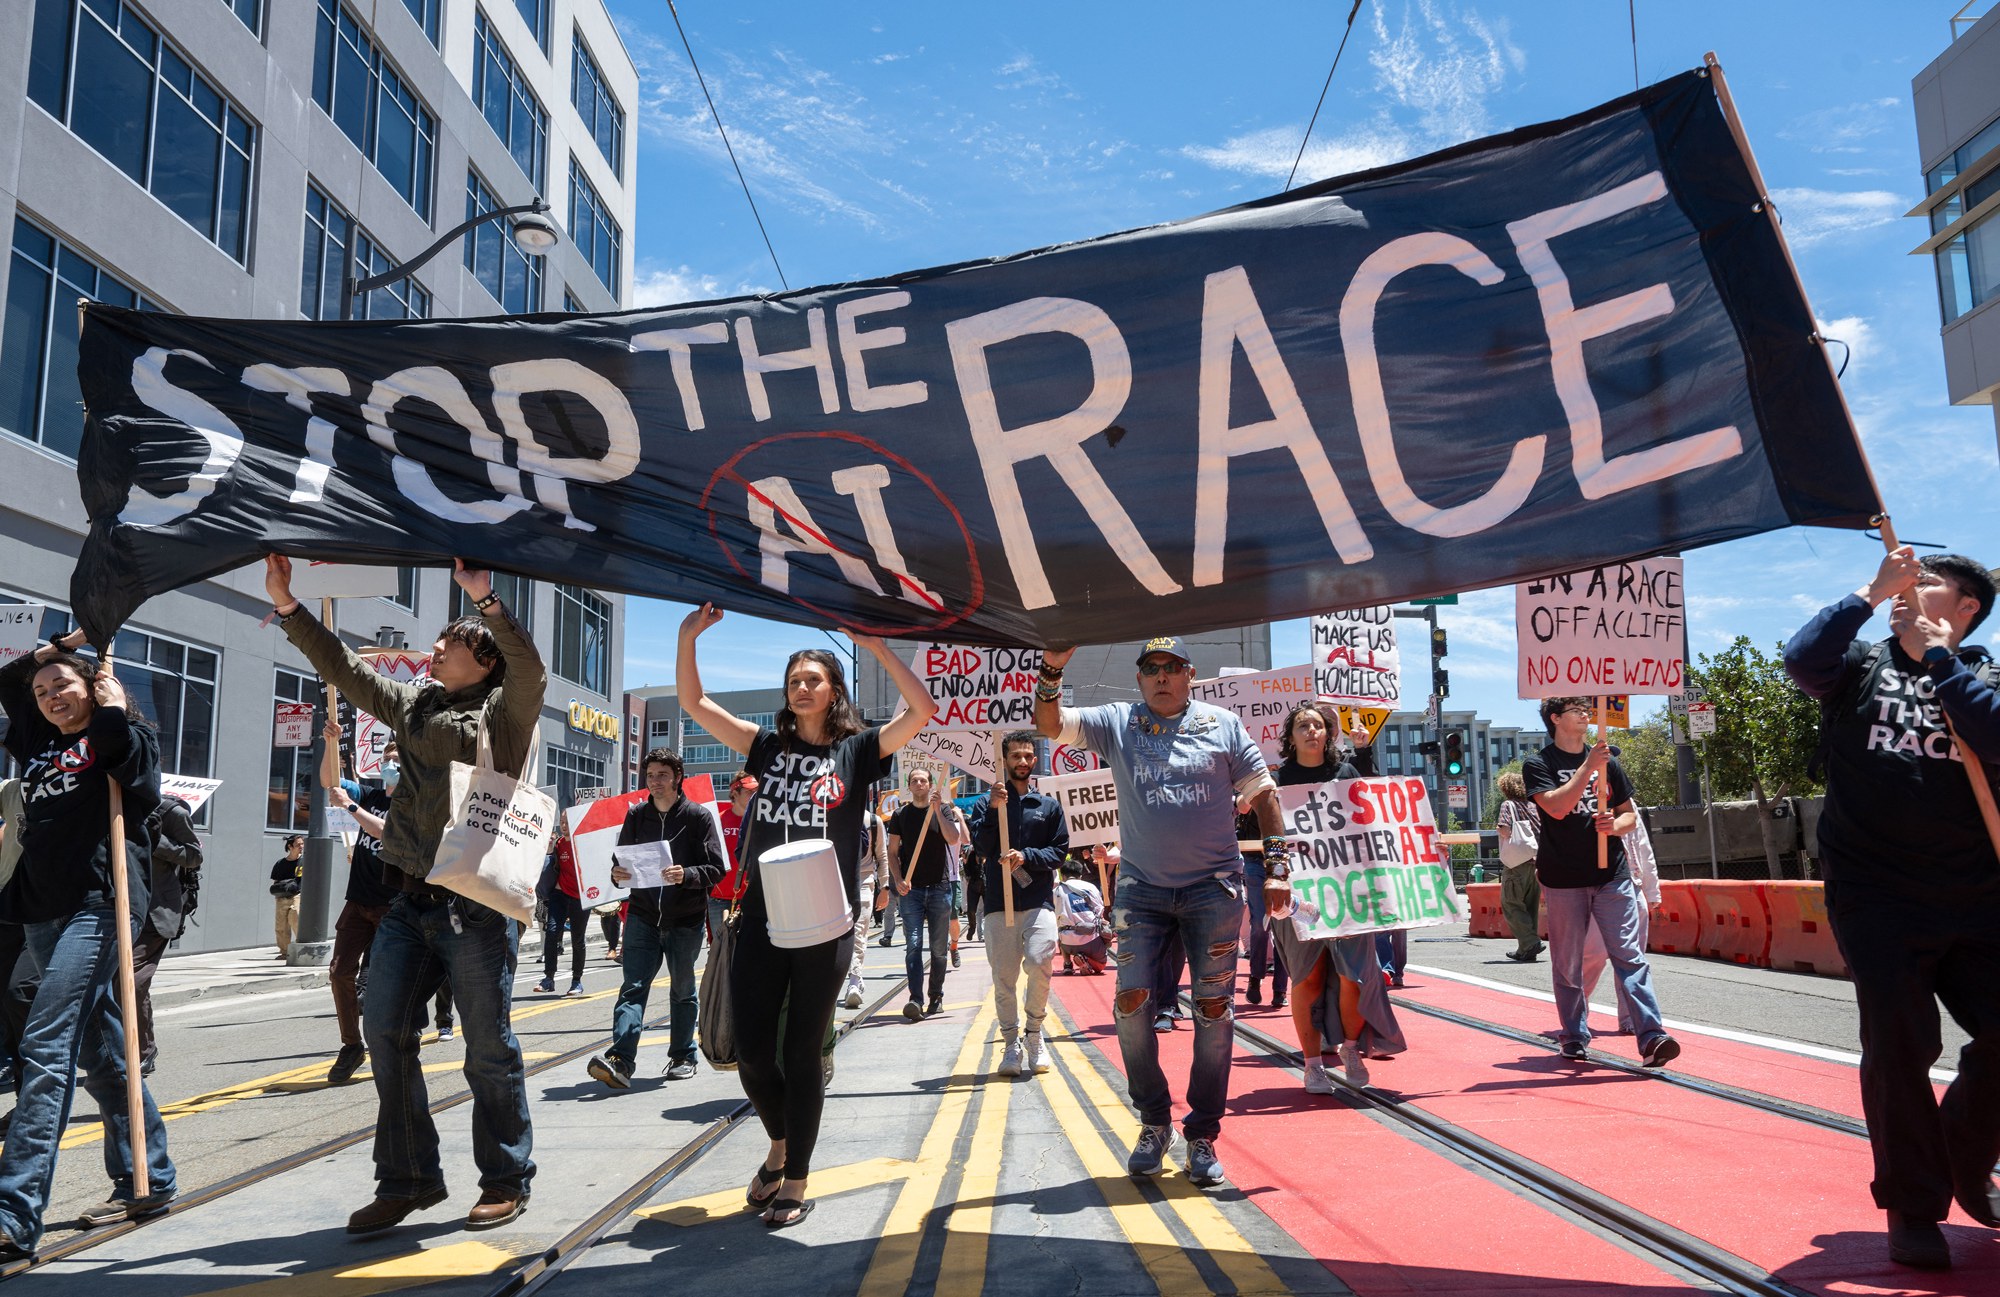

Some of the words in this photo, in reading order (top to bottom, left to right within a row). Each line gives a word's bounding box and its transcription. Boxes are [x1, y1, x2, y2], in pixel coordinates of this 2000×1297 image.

[630, 290, 928, 431] THE
[945, 170, 1743, 611] RACE
[117, 346, 641, 532] STOP
[747, 463, 944, 613] AI
[1586, 567, 1607, 601] A
[1617, 562, 1683, 608] RACE
[1319, 605, 1391, 625] WOULD
[1531, 606, 1591, 642] OFF
[1594, 607, 1610, 640] A
[1612, 610, 1682, 642] CLIFF
[1145, 636, 1177, 652] NAVY
[1315, 624, 1359, 648] MAKE
[1368, 628, 1392, 652] US
[926, 649, 981, 676] BAD
[983, 649, 1016, 673] TO
[1018, 649, 1043, 670] GE
[1327, 646, 1389, 672] ALL
[1528, 655, 1559, 686] NO
[1567, 656, 1616, 684] ONE
[1623, 658, 1683, 687] WINS
[925, 674, 974, 699] INTO
[975, 673, 999, 696] AN
[1190, 681, 1239, 700] THIS
[1315, 667, 1398, 701] HOMELESS
[1674, 692, 1702, 702] STOP
[1879, 668, 1937, 699] STO
[277, 715, 287, 723] NO
[287, 714, 312, 723] STOPPING
[568, 698, 619, 745] CAPCOM
[987, 696, 1034, 725] OVER
[1251, 702, 1283, 717] END
[1874, 694, 1947, 730] THE
[770, 751, 836, 777] STOP
[903, 760, 944, 771] FUTURE
[969, 743, 996, 773] Dies
[171, 779, 219, 792] HAVE
[762, 772, 813, 802] THE
[815, 776, 840, 801] AI
[1133, 763, 1172, 787] HAVE
[1557, 769, 1599, 783] STP
[469, 791, 480, 802] A
[483, 792, 509, 810] Path
[512, 805, 528, 819] for
[530, 813, 543, 828] All
[1068, 784, 1116, 806] FREE
[1145, 782, 1211, 808] ENOUGH!
[1282, 791, 1346, 836] Let's
[1348, 779, 1425, 825] STOP
[468, 804, 501, 820] From
[503, 815, 538, 840] Kinder
[756, 797, 829, 827] RACE
[1071, 809, 1119, 832] NOW!
[466, 818, 479, 828] to
[482, 822, 519, 847] Career
[1286, 830, 1401, 872] FRONTIER
[1399, 825, 1440, 865] AI
[1292, 865, 1458, 931] TOGETHER
